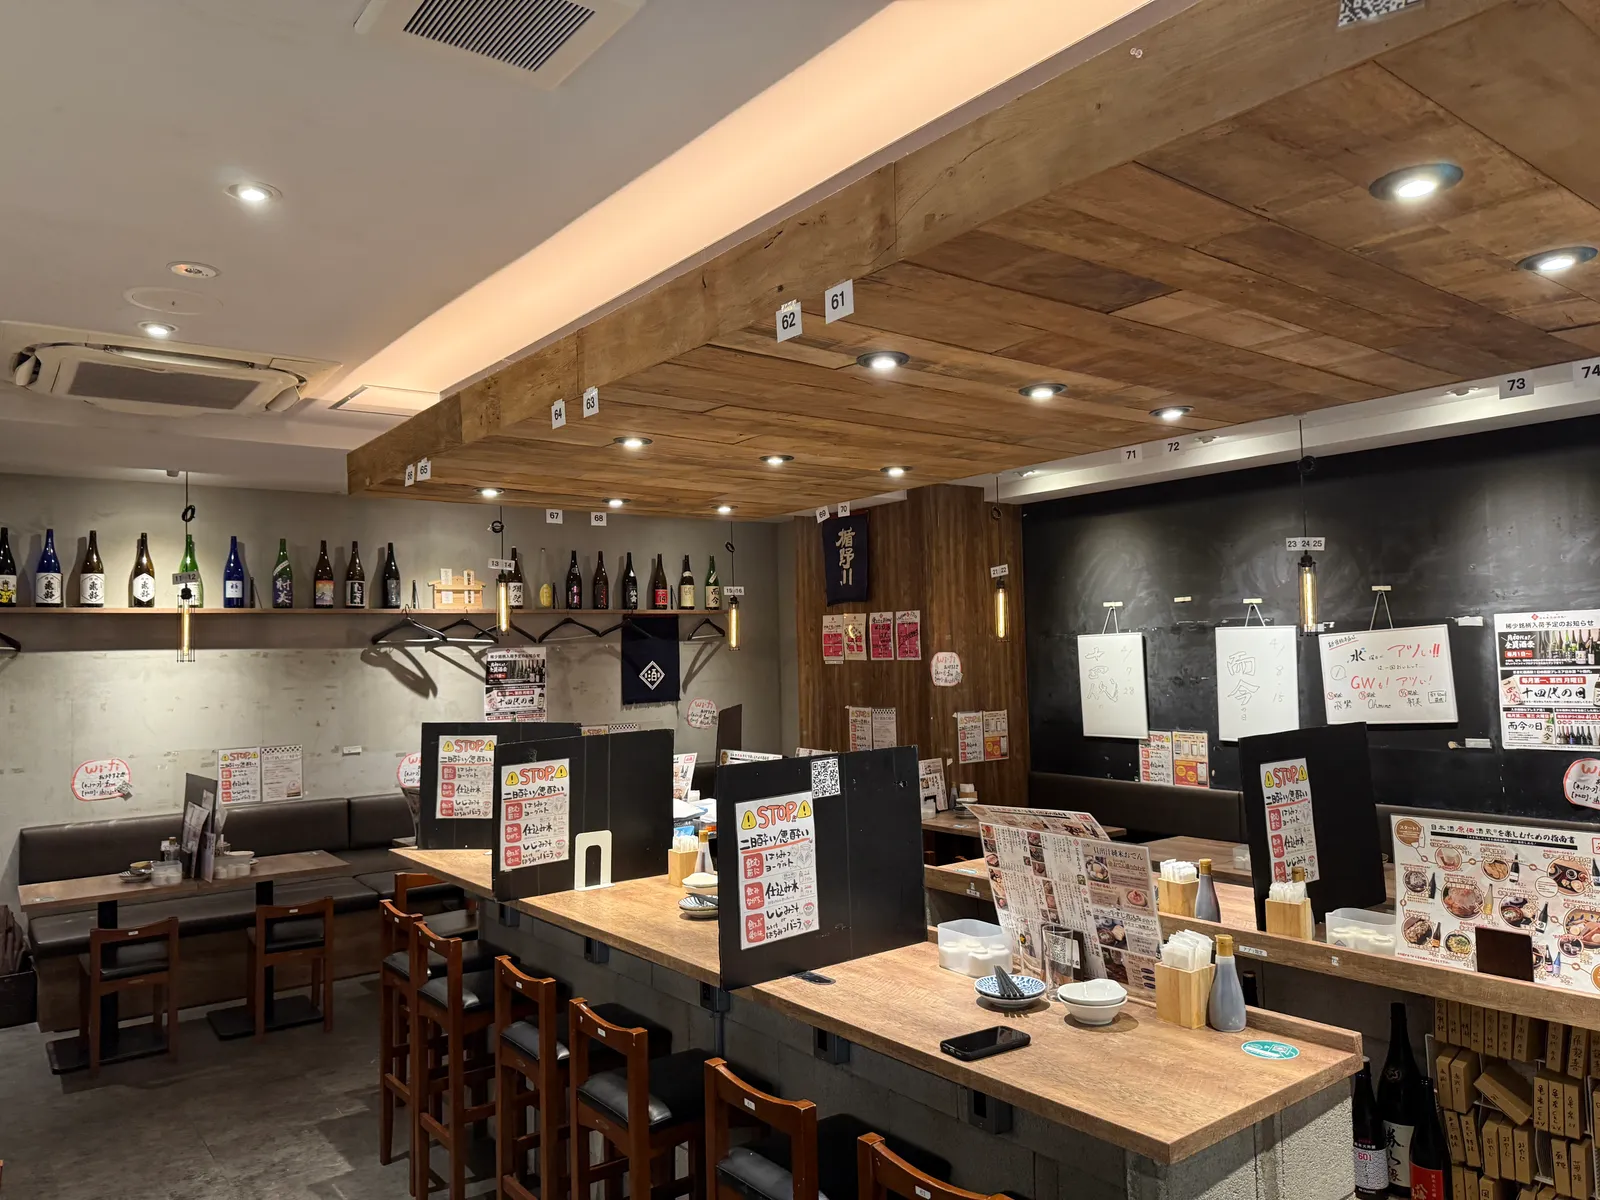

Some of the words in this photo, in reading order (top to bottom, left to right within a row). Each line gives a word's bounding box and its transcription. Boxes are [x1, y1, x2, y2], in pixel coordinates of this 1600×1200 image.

[831, 291, 845, 310] 61
[781, 311, 796, 330] 62
[1582, 365, 1600, 379] 74
[1507, 378, 1526, 391] 73
[586, 396, 595, 410] 63
[554, 409, 562, 421] 64
[1168, 441, 1180, 452] 72
[1126, 450, 1136, 460] 71
[419, 465, 428, 475] 65
[818, 509, 827, 519] 69
[840, 505, 848, 513] 70
[549, 512, 559, 520] 67
[594, 514, 604, 522] 68
[1287, 539, 1297, 548] 23
[1301, 539, 1310, 548] 24
[1313, 539, 1323, 548] 25
[1350, 648, 1367, 662] 水
[454, 739, 485, 754] STOP
[229, 751, 251, 762] STOP
[519, 765, 555, 786] STOP
[1273, 765, 1298, 788] STOP
[757, 801, 797, 829] STOP
[523, 823, 553, 836] 仕込み水
[765, 860, 793, 873] ヨーグルト
[765, 879, 800, 898] 仕込み水
[766, 902, 800, 920] しじみ汁
